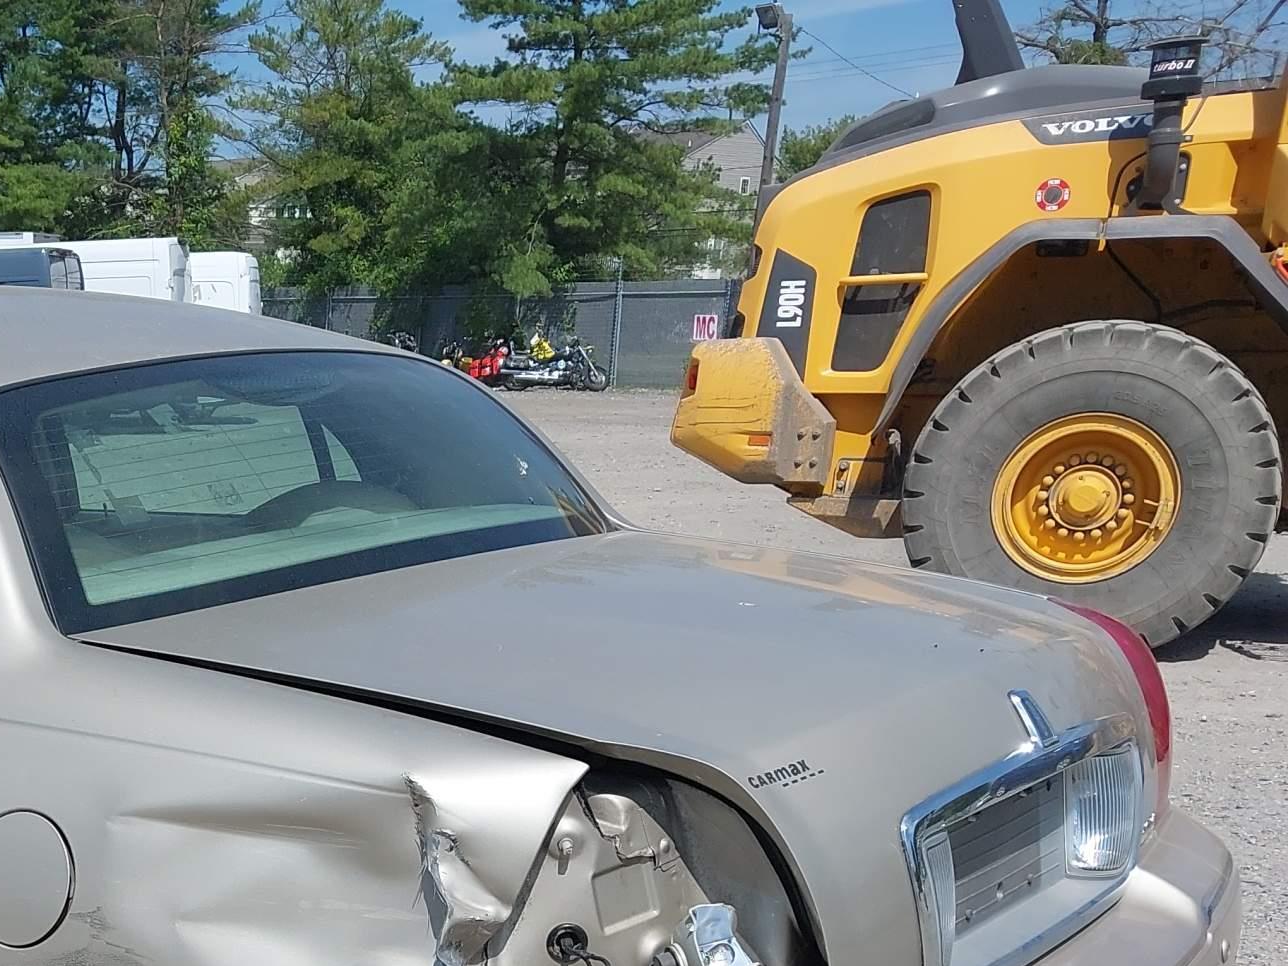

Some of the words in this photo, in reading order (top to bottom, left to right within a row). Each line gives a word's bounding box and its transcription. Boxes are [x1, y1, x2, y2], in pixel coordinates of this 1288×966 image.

[1153, 60, 1184, 72] turbo
[776, 280, 806, 327] L90H
[696, 316, 716, 339] MC
